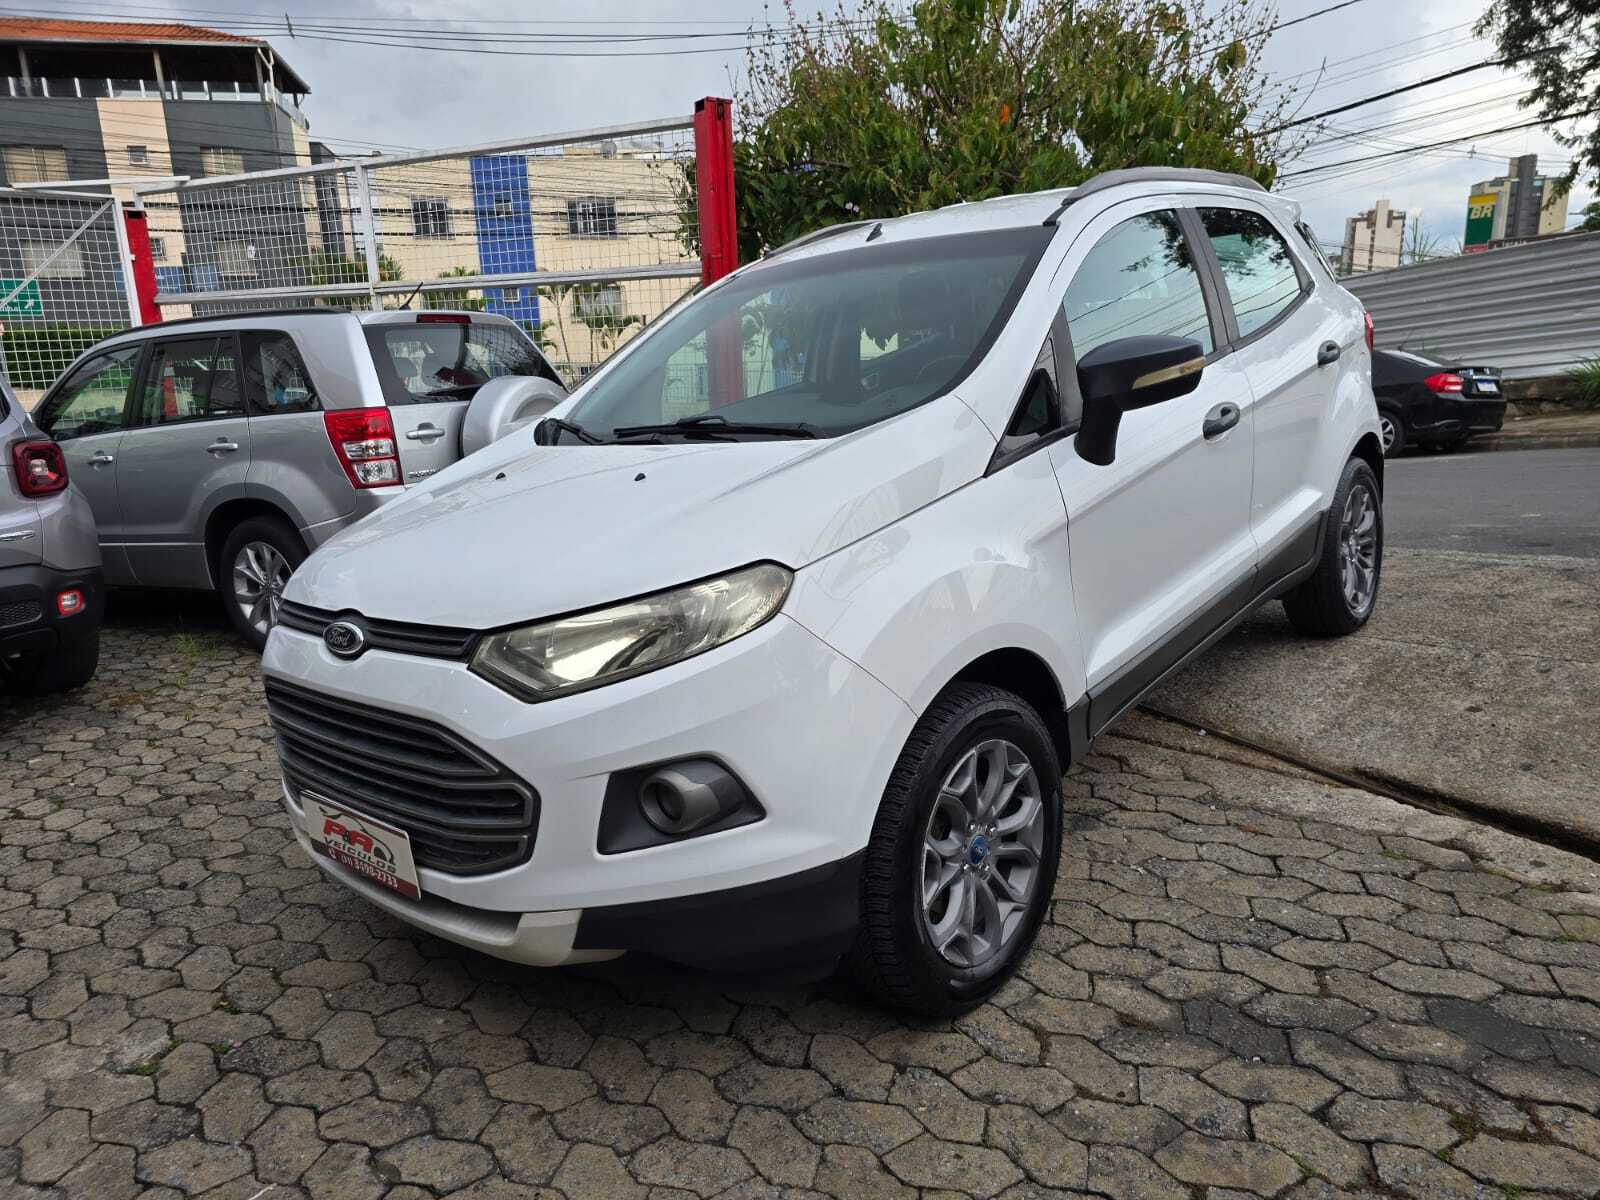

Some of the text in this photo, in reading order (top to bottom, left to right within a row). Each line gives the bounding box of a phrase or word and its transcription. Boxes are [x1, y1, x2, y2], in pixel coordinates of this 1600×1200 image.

[1470, 204, 1493, 219] BR
[326, 626, 352, 646] Ford
[323, 819, 374, 853] P&A
